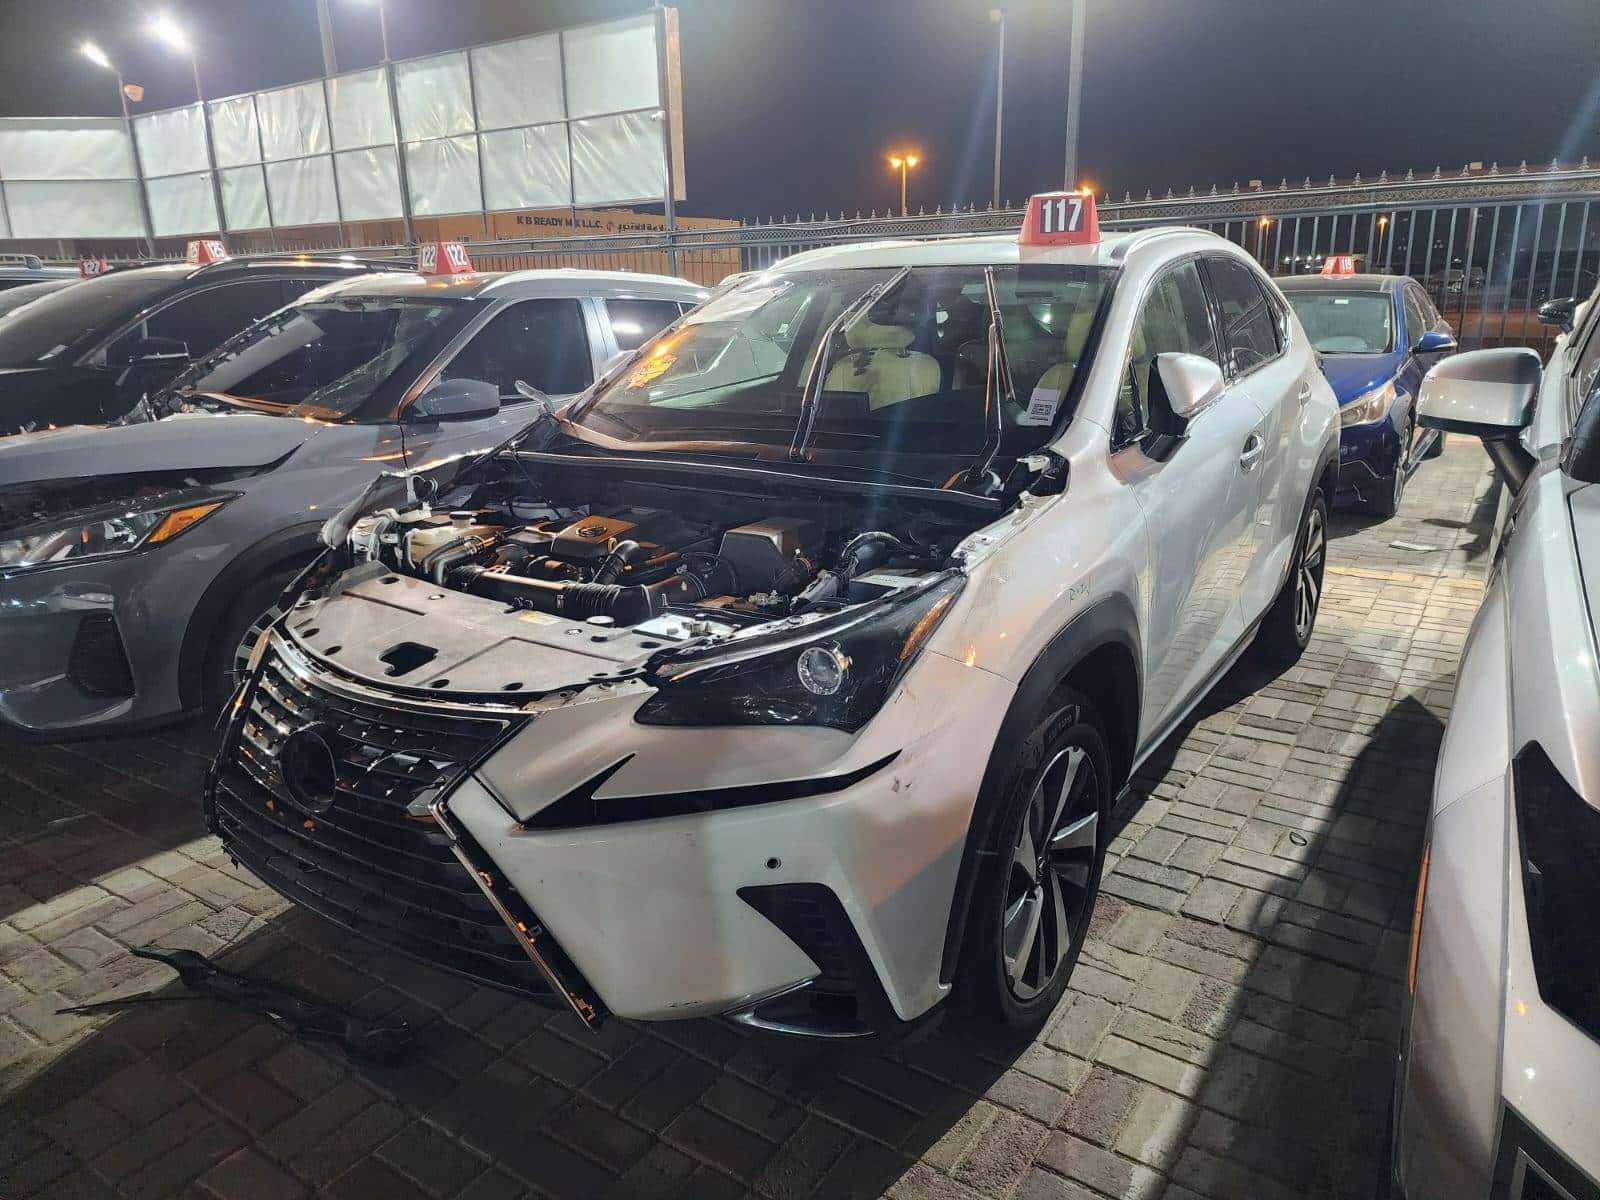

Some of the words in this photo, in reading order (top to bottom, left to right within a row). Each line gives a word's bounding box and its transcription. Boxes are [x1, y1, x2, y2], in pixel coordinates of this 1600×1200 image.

[533, 216, 563, 227] READY
[1042, 198, 1082, 232] 117
[422, 244, 436, 267] 122
[446, 243, 469, 267] 122
